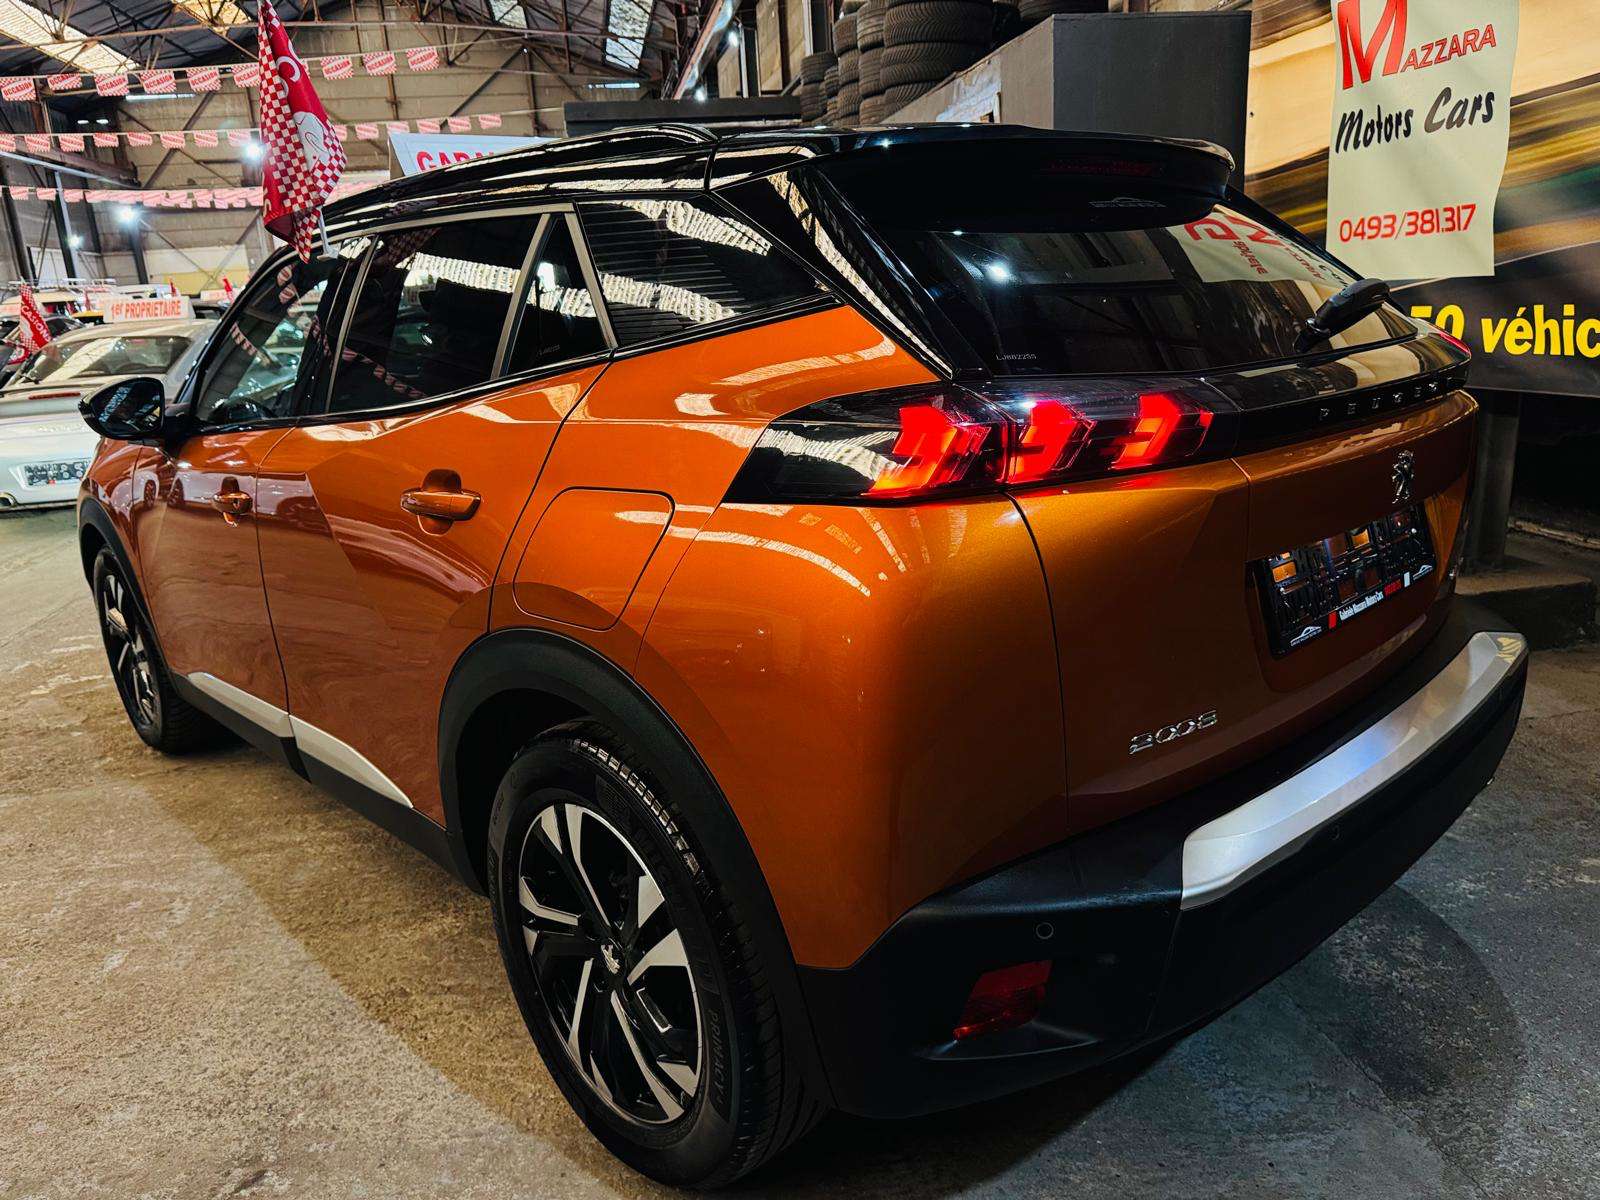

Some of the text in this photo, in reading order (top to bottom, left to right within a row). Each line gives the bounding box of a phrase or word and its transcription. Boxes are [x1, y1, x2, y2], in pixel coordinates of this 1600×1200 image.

[1337, 0, 1496, 90] MAZZARA
[1335, 86, 1495, 154] Motors Cars
[1129, 709, 1218, 755] 2008
